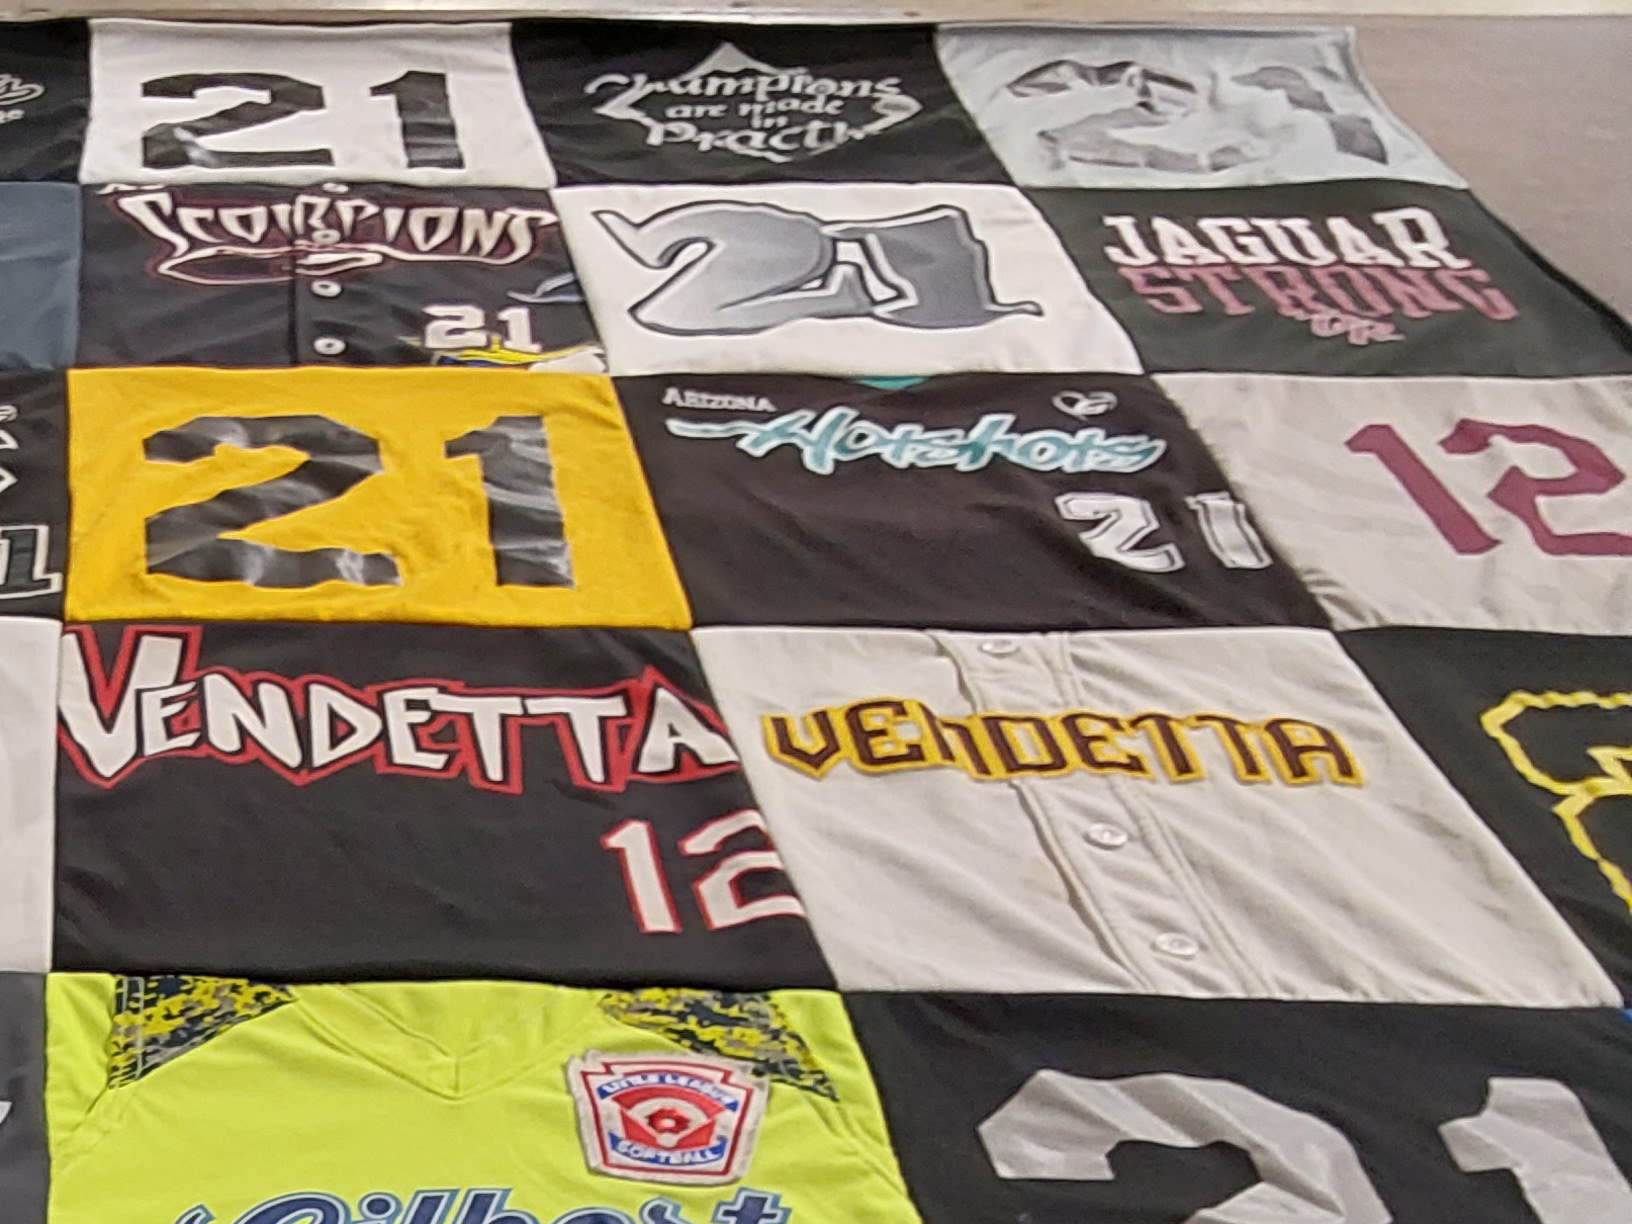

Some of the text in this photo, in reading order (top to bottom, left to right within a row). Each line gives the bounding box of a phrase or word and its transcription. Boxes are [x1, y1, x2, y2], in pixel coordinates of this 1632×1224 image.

[141, 69, 465, 170] 21
[665, 103, 729, 119] are
[738, 95, 845, 116] made
[751, 111, 789, 128] in
[1101, 206, 1472, 270] JAGUAR
[1117, 264, 1519, 321] STRONG
[421, 304, 543, 353] 21
[661, 386, 778, 413] ARIZONA
[142, 413, 576, 590] 21
[1343, 417, 1632, 556] 12
[1054, 490, 1274, 573] 21
[56, 624, 741, 795] VENDETTA
[601, 808, 807, 934] 12
[616, 1139, 723, 1166] SOFTBALL
